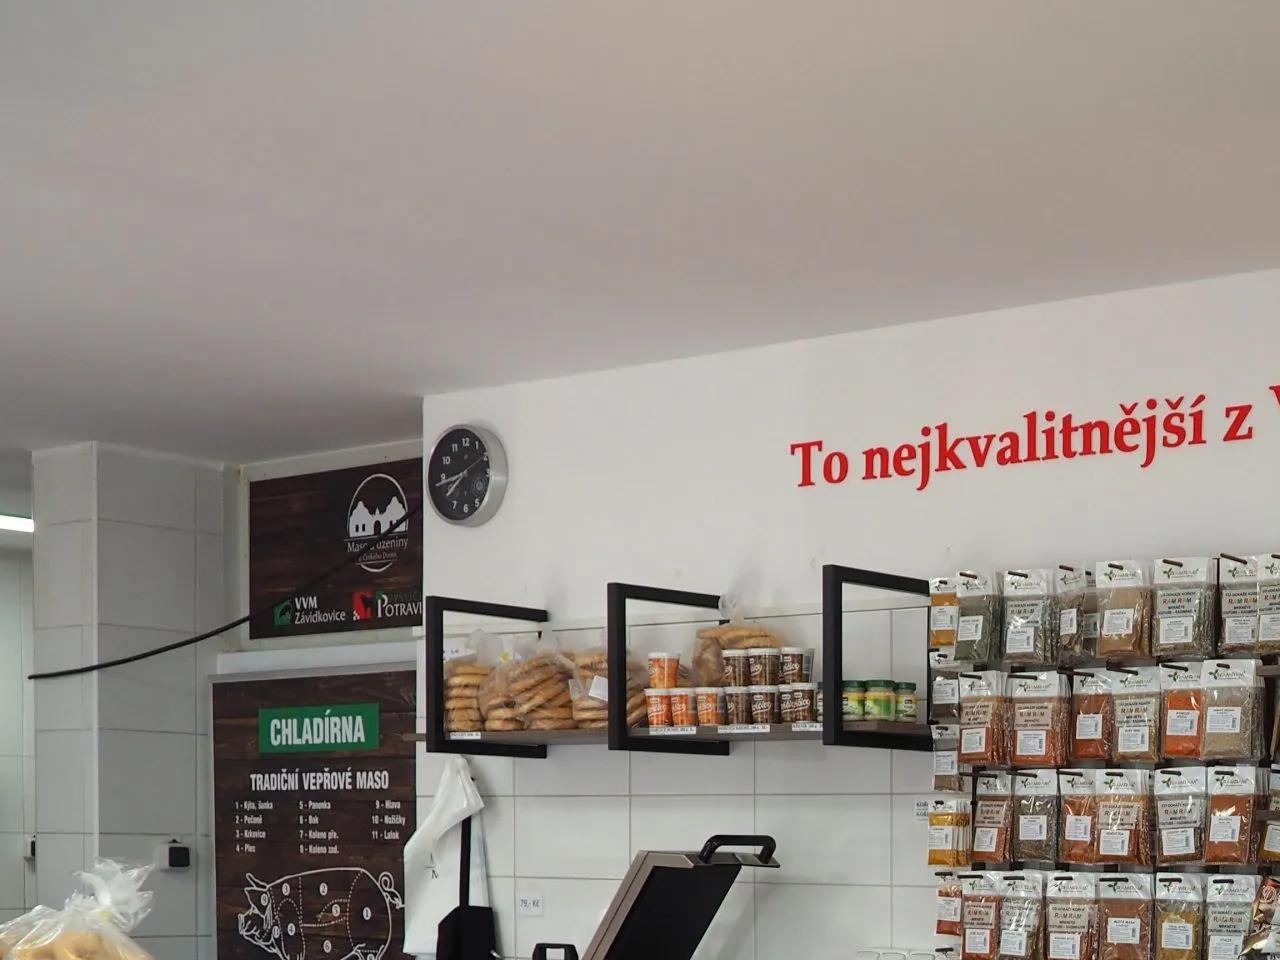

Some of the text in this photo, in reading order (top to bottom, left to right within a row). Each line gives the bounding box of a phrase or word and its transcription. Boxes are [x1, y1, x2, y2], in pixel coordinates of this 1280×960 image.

[462, 438, 470, 447] 12
[790, 440, 849, 487] To
[862, 394, 1206, 491] nejkvalitnější
[1222, 405, 1253, 441] z
[452, 444, 458, 453] 11
[442, 456, 451, 465] 10
[452, 500, 457, 510] 7
[475, 498, 480, 507] 5
[463, 504, 469, 513] 6
[294, 596, 317, 610] VVM
[270, 709, 365, 746] CHLADÍRNA
[250, 767, 389, 791] TRADIČNÍ VEPŘOVÉ MASO
